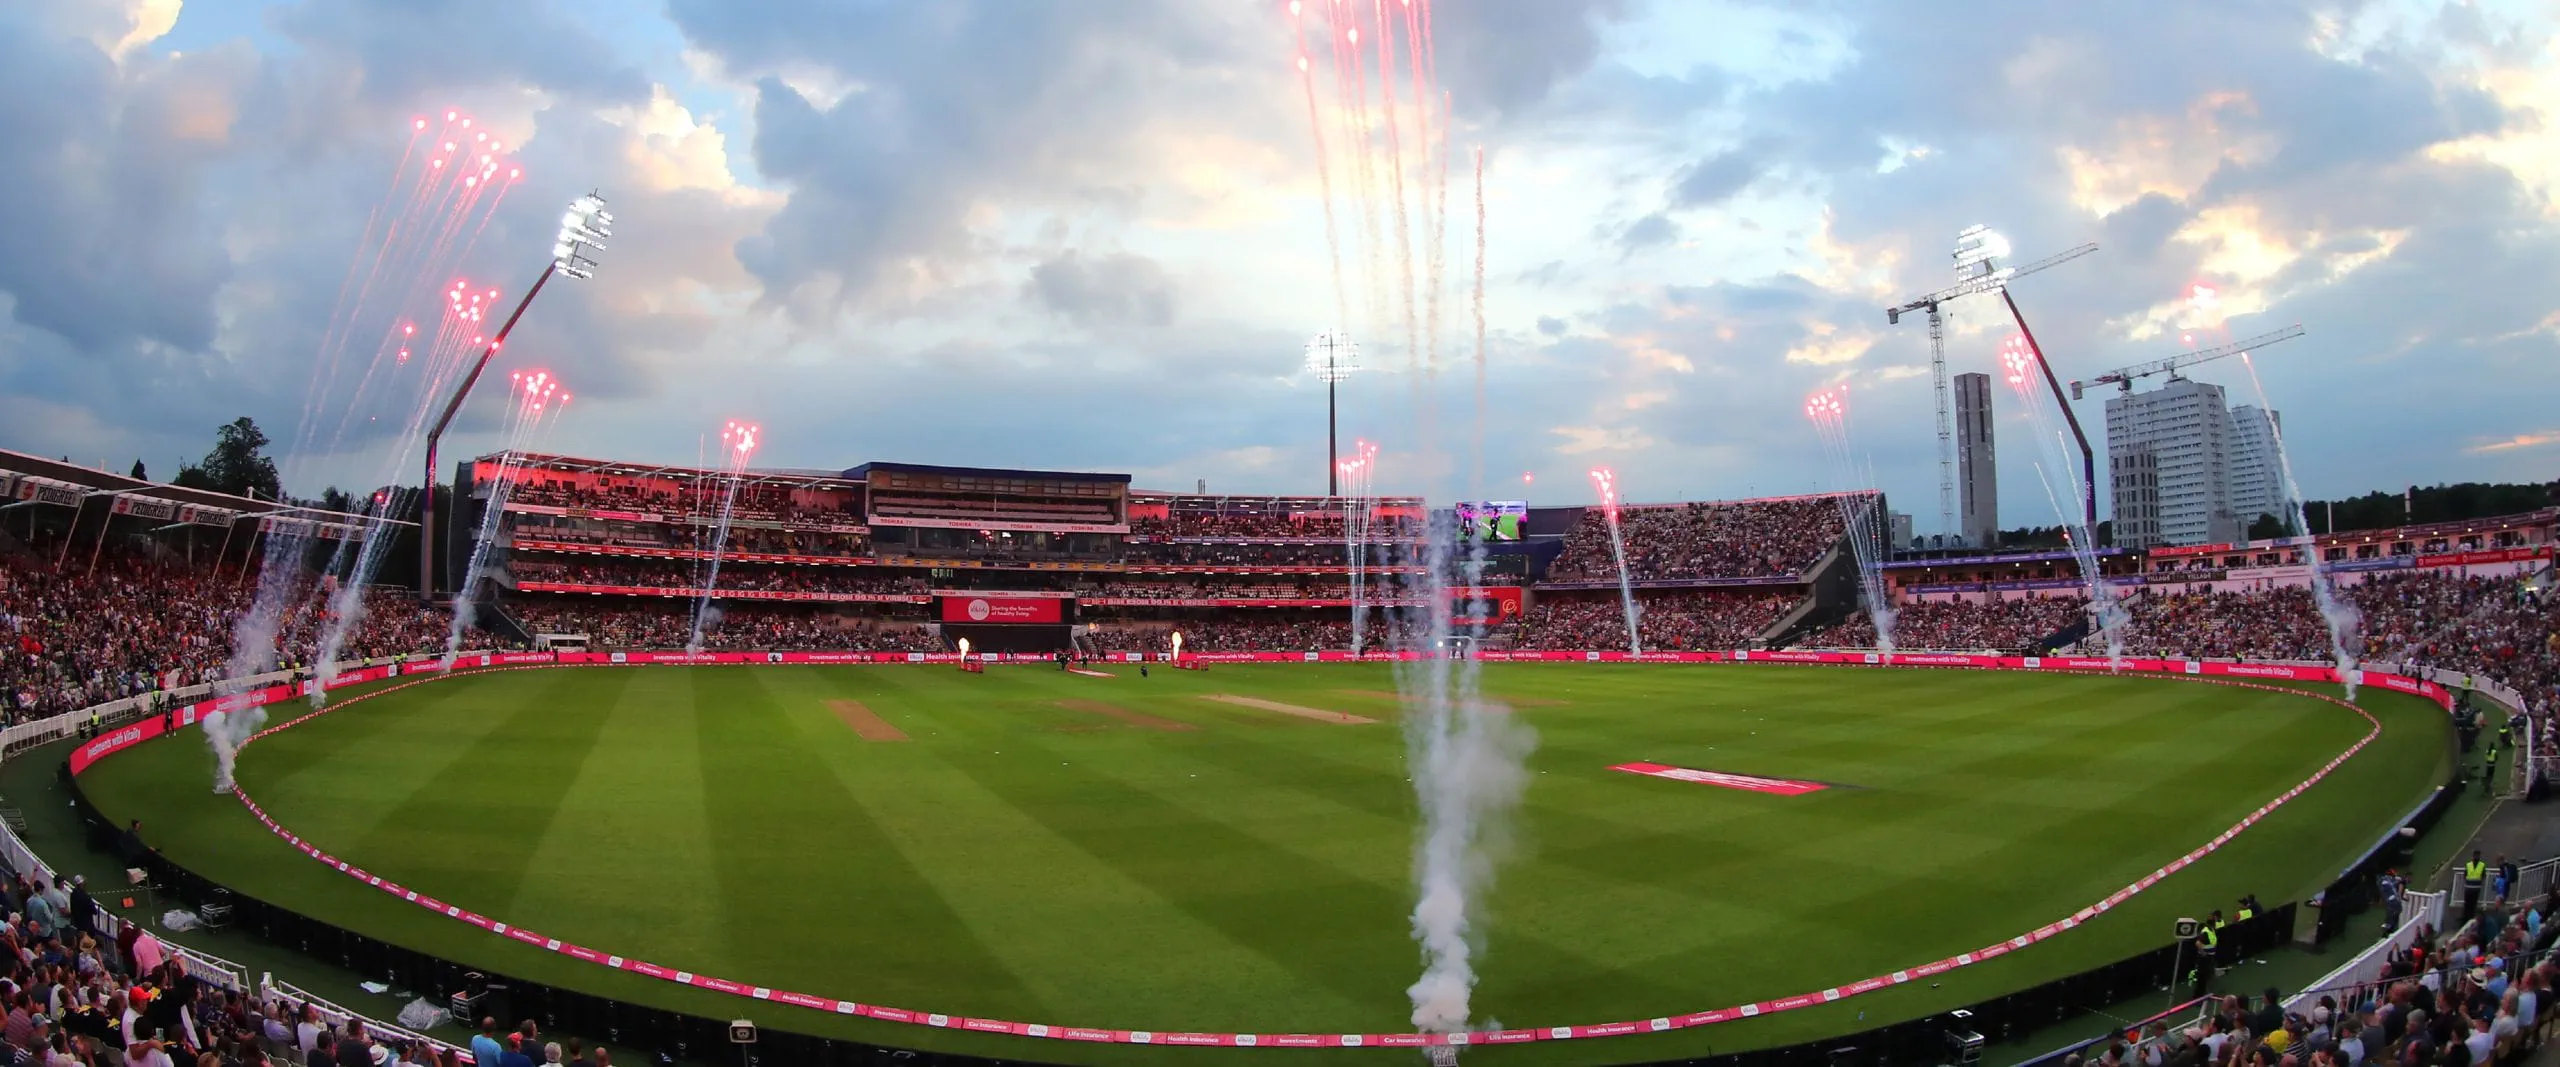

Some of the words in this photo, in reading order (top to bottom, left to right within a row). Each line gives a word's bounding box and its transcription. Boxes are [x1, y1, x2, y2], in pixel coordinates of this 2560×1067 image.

[37, 486, 77, 505] PEDIGREE
[131, 503, 168, 518] PEDIGREE
[195, 511, 227, 526] PEDIGREE
[697, 653, 716, 661] Vitality
[926, 653, 948, 661] Health
[1237, 653, 1255, 661] Vitality
[1950, 656, 1971, 664] Vitality
[2227, 665, 2259, 674] Investments
[2260, 667, 2273, 675] with
[2273, 667, 2294, 678] Vitality
[87, 738, 112, 758] Investments
[112, 733, 124, 748] with
[124, 727, 141, 743] Vitality
[782, 994, 799, 1002] Health
[800, 997, 824, 1006] Insurance
[1785, 998, 1808, 1007] Insurance
[874, 1009, 908, 1019] Investments
[1689, 1013, 1723, 1023] Investments
[979, 1022, 1007, 1030] Insurance
[1587, 1027, 1607, 1035] Health
[1607, 1025, 1635, 1033] Insurance
